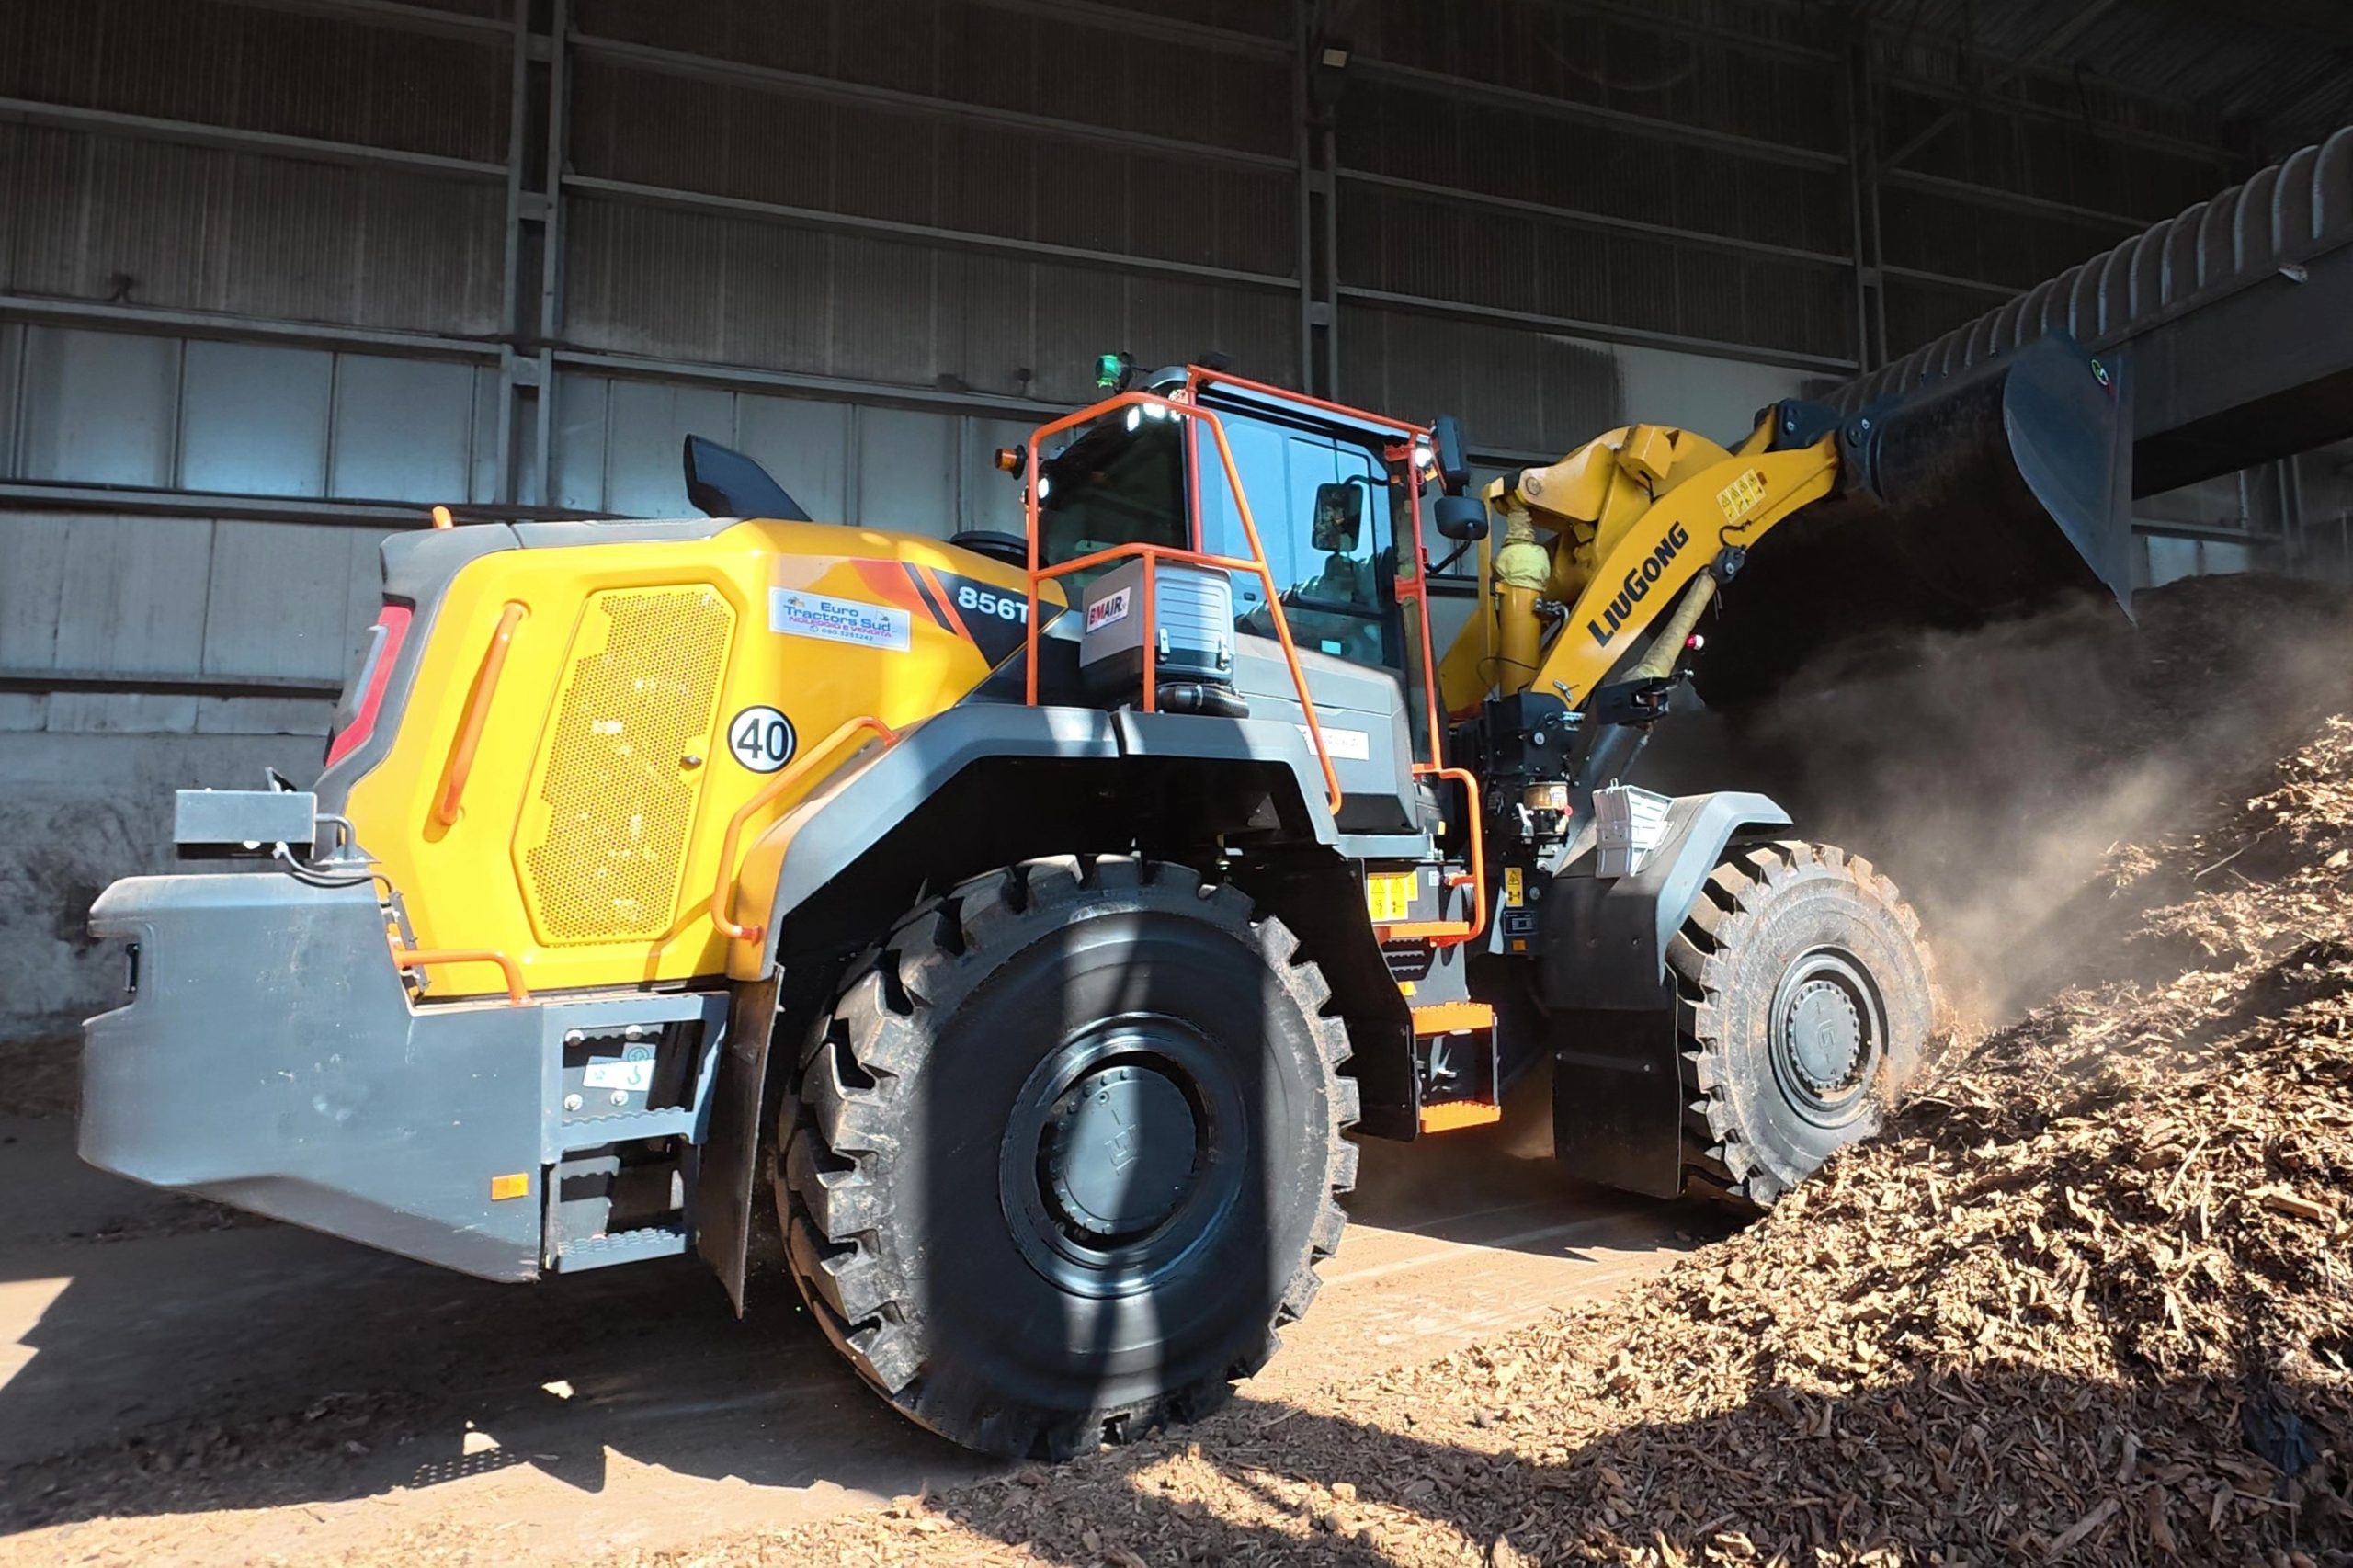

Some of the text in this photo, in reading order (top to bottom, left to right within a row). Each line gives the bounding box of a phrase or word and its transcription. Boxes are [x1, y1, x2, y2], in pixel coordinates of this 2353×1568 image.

[1586, 520, 1689, 648] LIUGONG
[783, 604, 891, 631] Tractors Sud
[820, 601, 859, 618] Euro
[958, 585, 1029, 624] 856T
[789, 616, 842, 631] NOLEGGIO
[850, 626, 892, 638] VENDITA
[736, 717, 790, 762] 40
